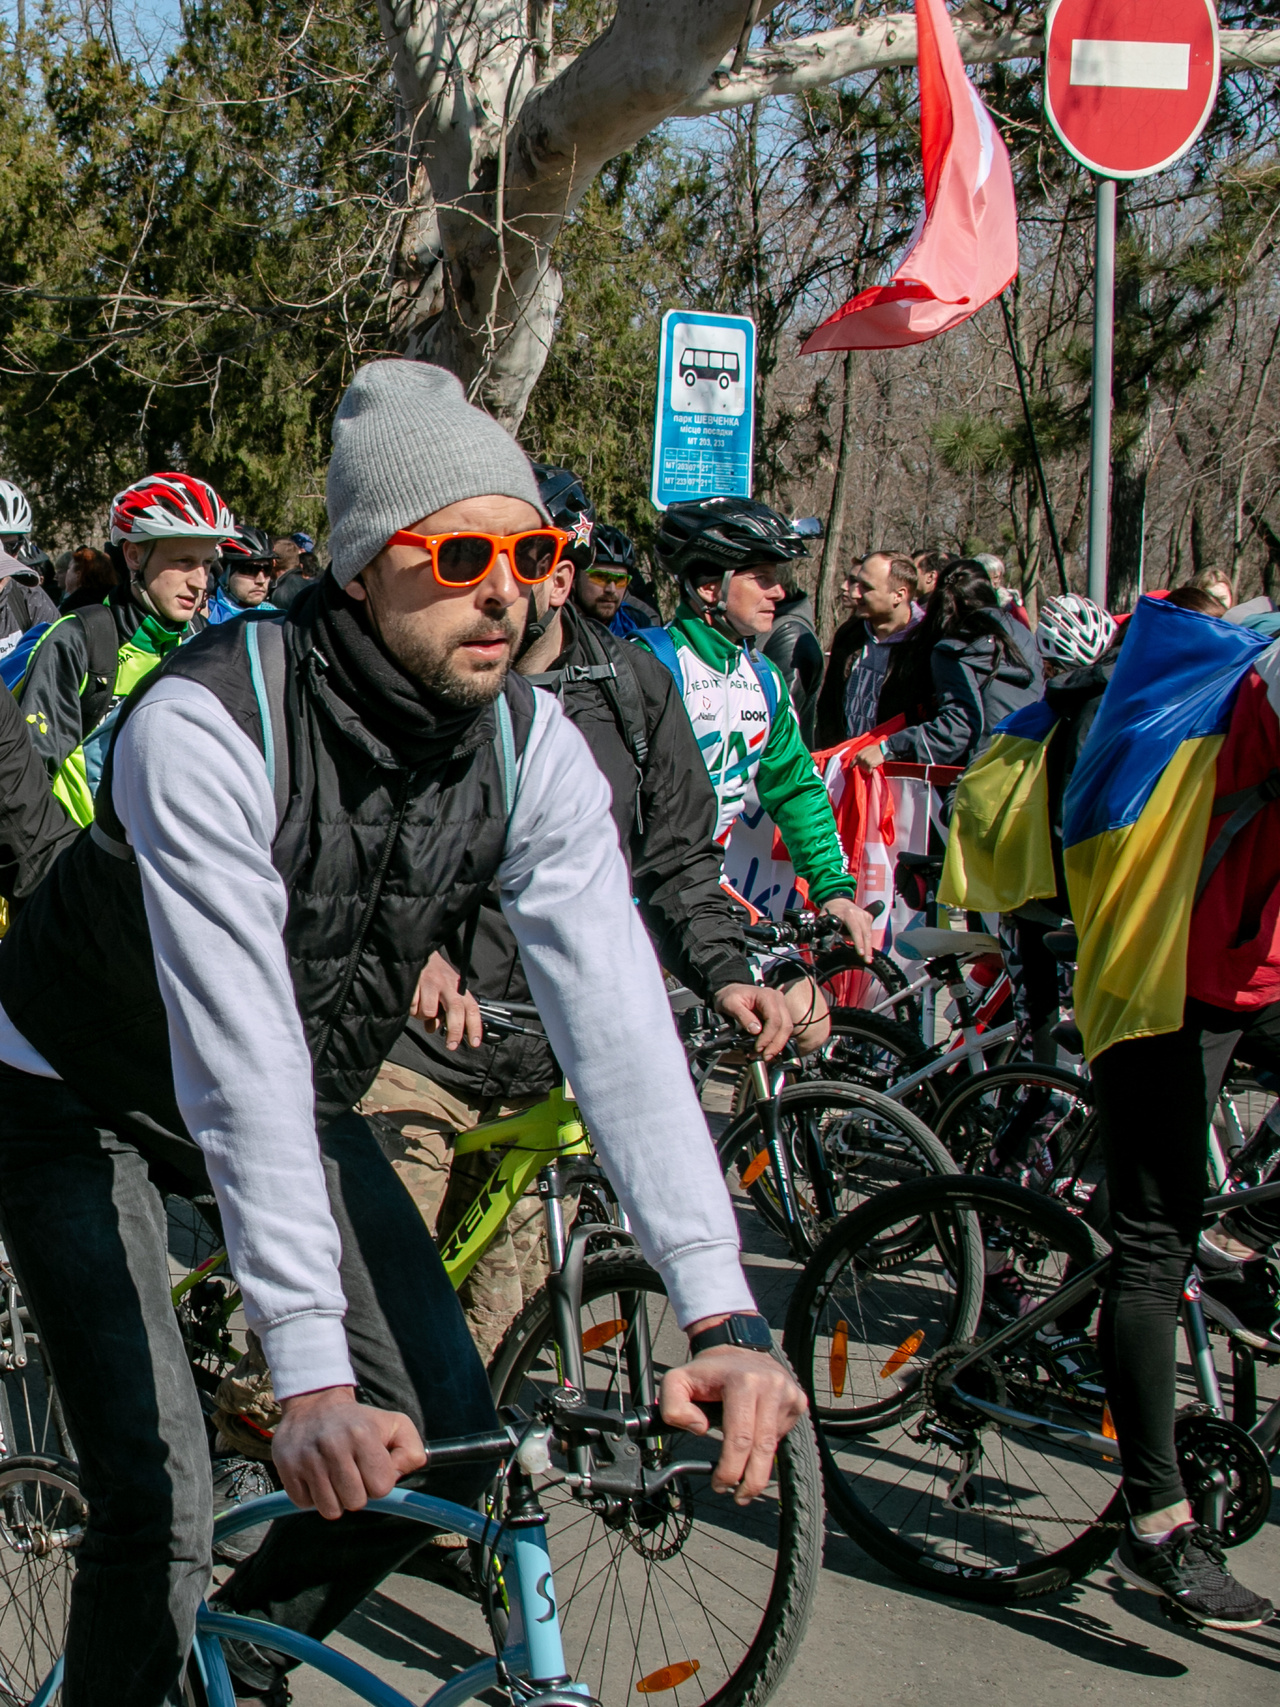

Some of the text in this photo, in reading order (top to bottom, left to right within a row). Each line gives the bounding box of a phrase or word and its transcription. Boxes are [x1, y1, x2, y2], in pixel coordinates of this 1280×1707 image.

[673, 414, 739, 426] парк ШЕВЧЕНКА
[680, 425, 733, 436] місце посадки
[687, 437, 698, 445] МТ
[665, 461, 676, 469] МТ
[664, 477, 675, 485] МТ
[740, 709, 768, 722] LOOK
